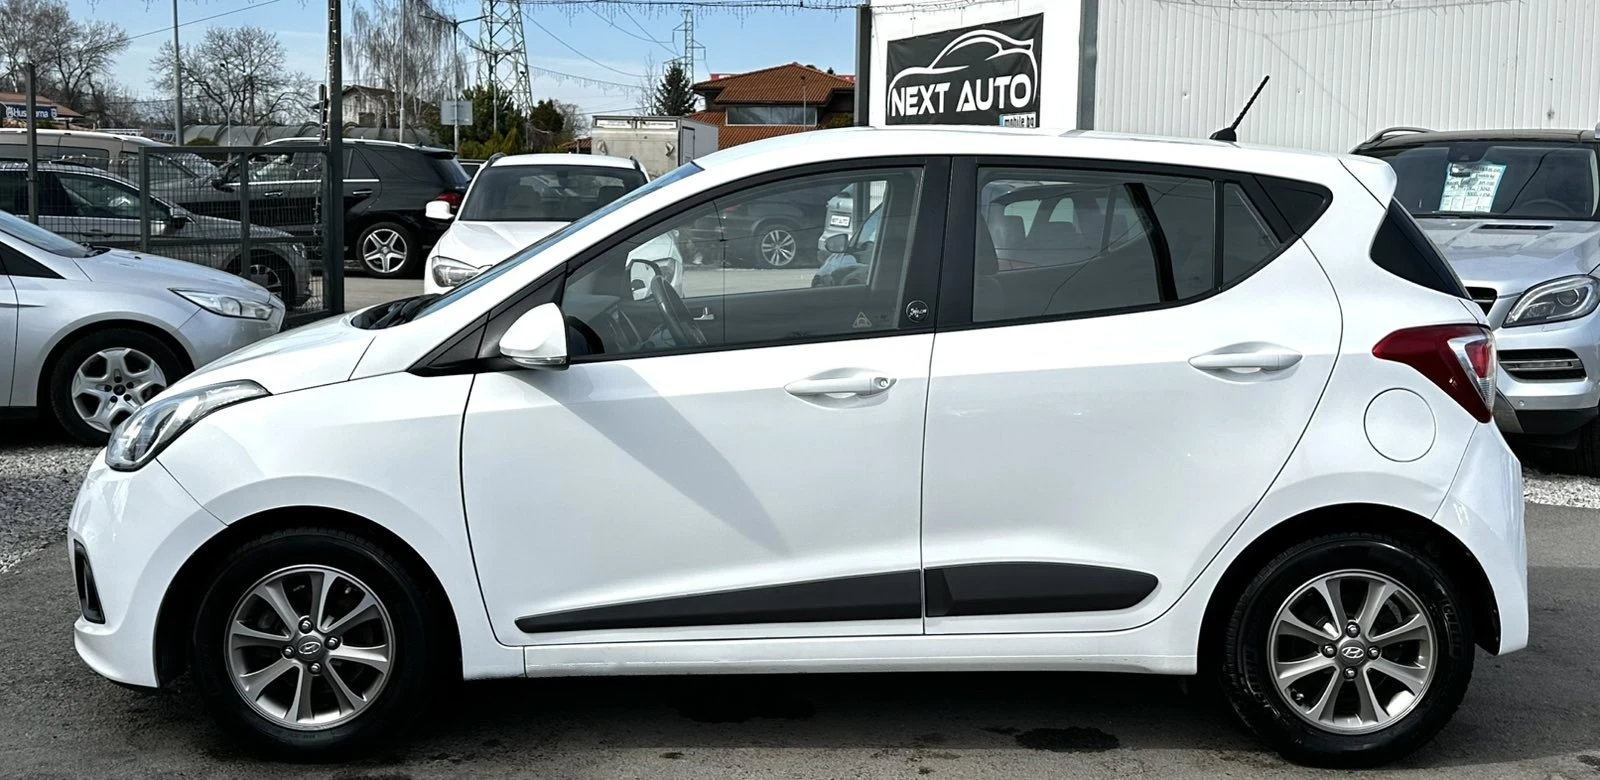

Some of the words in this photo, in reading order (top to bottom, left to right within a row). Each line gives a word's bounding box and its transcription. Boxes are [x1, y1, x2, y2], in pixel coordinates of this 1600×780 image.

[891, 82, 951, 117] NEXT
[955, 73, 1032, 112] AUTO
[13, 107, 49, 118] Husrna
